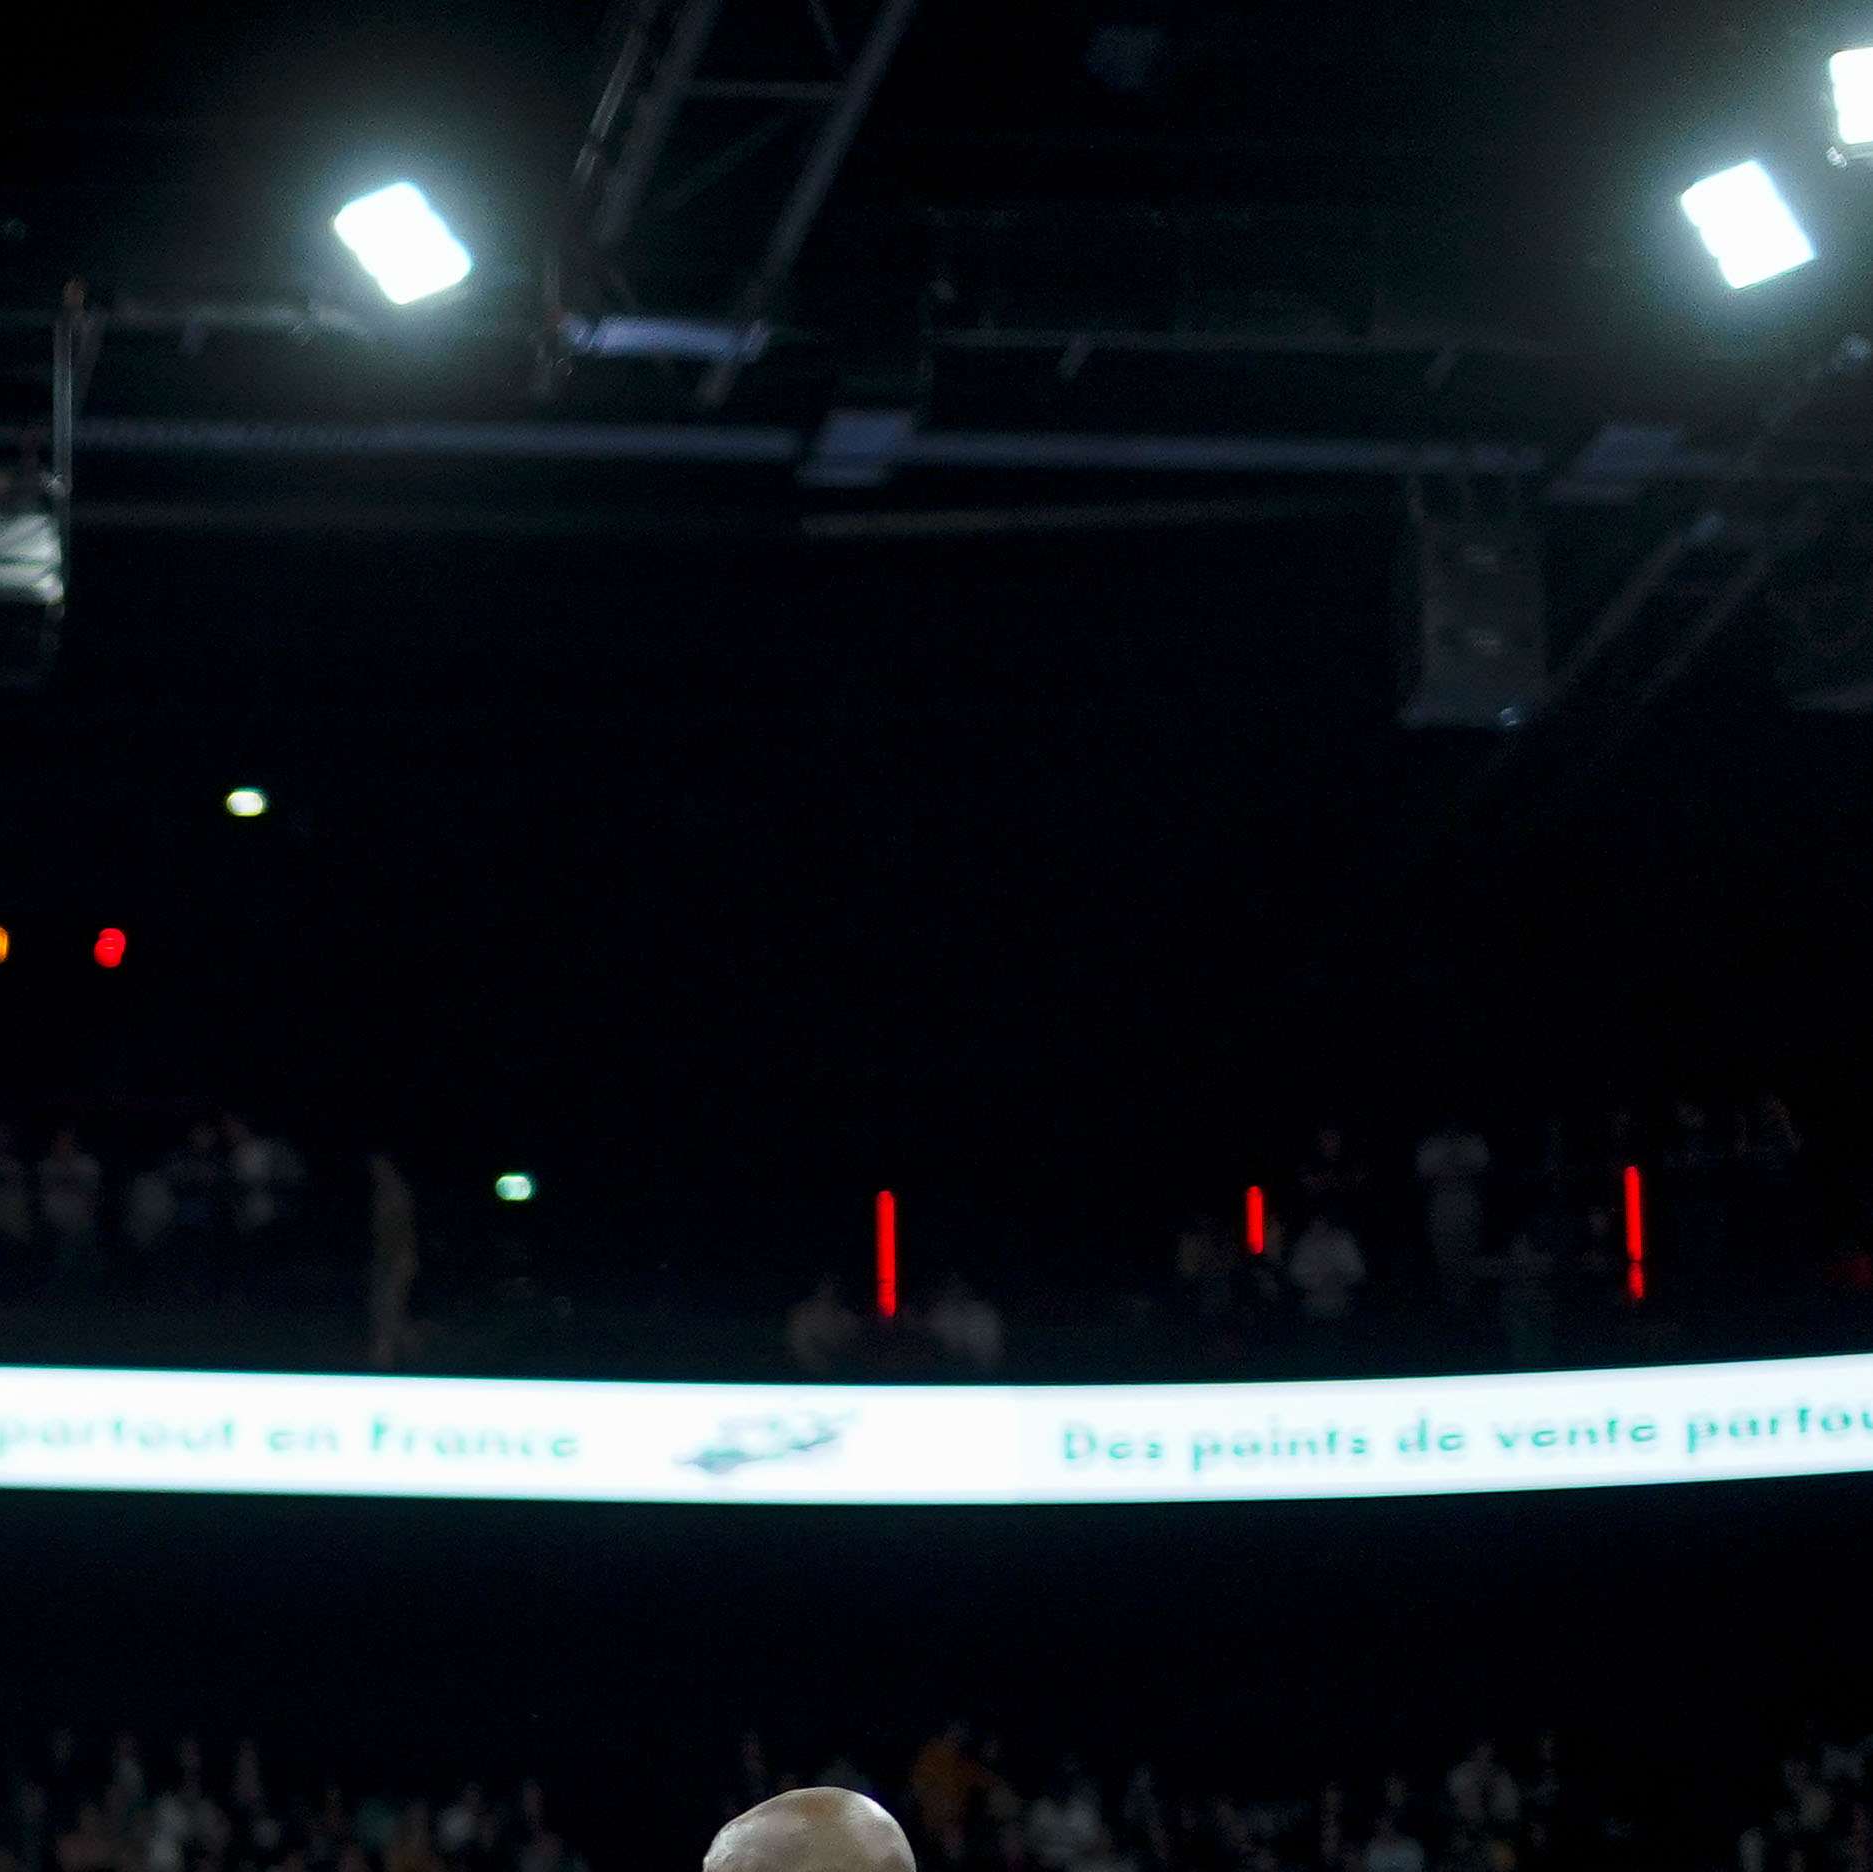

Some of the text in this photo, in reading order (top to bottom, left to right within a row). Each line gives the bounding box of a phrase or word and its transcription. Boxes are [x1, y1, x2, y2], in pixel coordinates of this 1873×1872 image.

[263, 1419, 343, 1457] en
[369, 1405, 583, 1460] France
[1062, 1420, 1167, 1464] Des
[1186, 1414, 1373, 1479] points
[1395, 1408, 1468, 1458] de
[1494, 1409, 1664, 1452] vente
